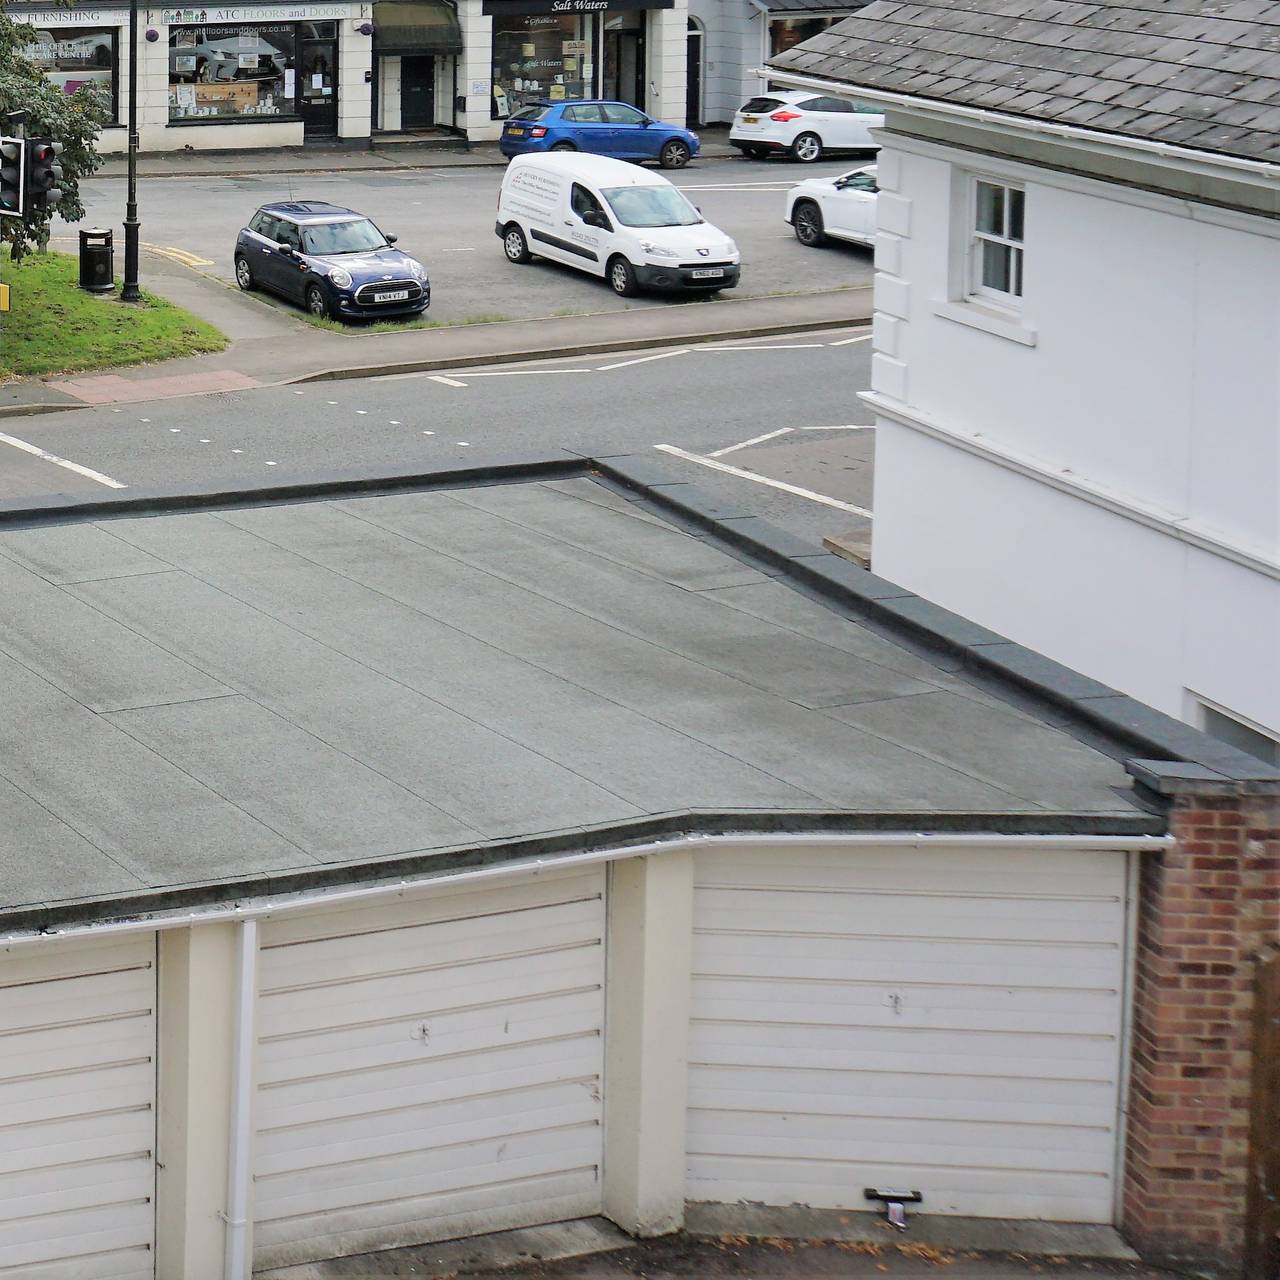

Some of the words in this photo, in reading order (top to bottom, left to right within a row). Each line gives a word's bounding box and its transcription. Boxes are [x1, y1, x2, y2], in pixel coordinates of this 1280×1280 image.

[552, 0, 571, 11] Salt
[574, 0, 608, 10] Waters
[27, 11, 101, 22] FURNISHING
[216, 9, 240, 19] ATC
[289, 7, 306, 17] and
